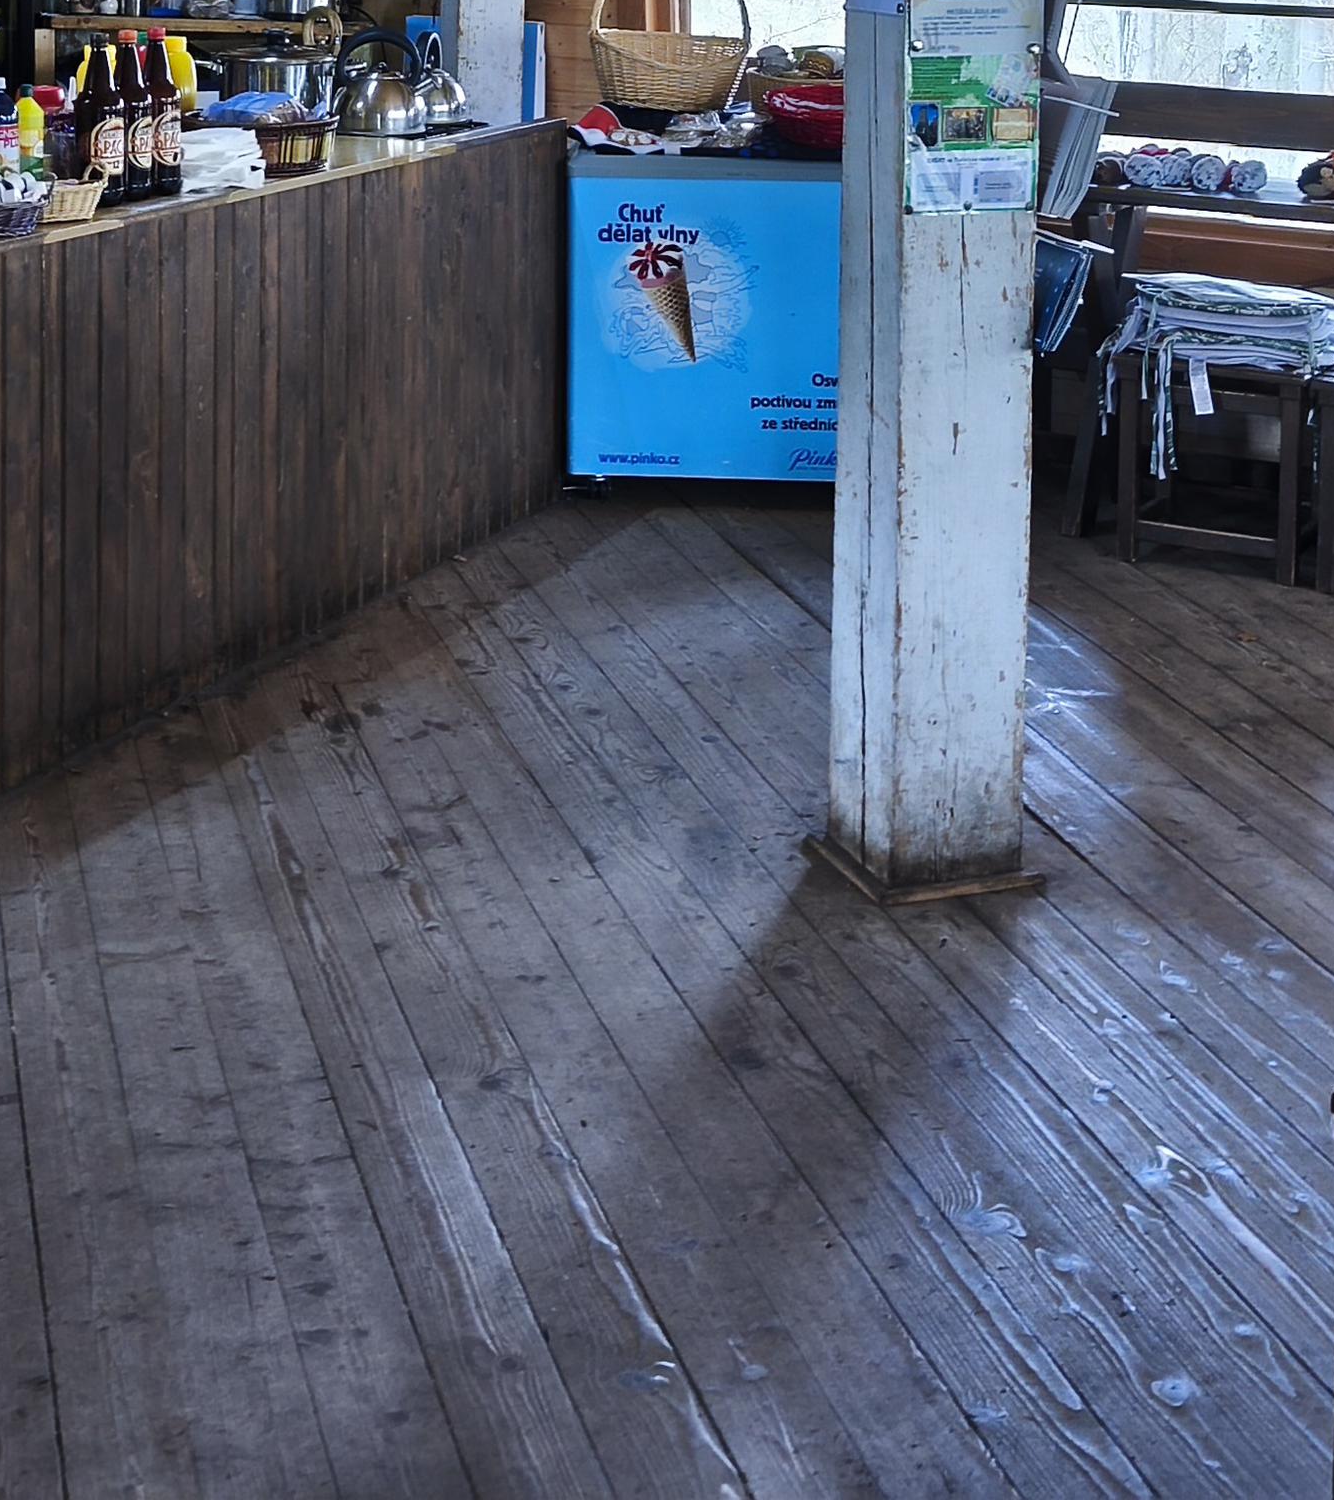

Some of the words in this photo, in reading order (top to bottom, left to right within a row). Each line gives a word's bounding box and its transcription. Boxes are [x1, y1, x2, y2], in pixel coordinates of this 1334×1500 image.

[617, 203, 666, 223] Chuť
[598, 224, 651, 243] dělat
[658, 224, 699, 244] vlny
[751, 394, 812, 409] poctivou
[761, 418, 778, 430] ze
[598, 453, 680, 467] www.pinko.cz
